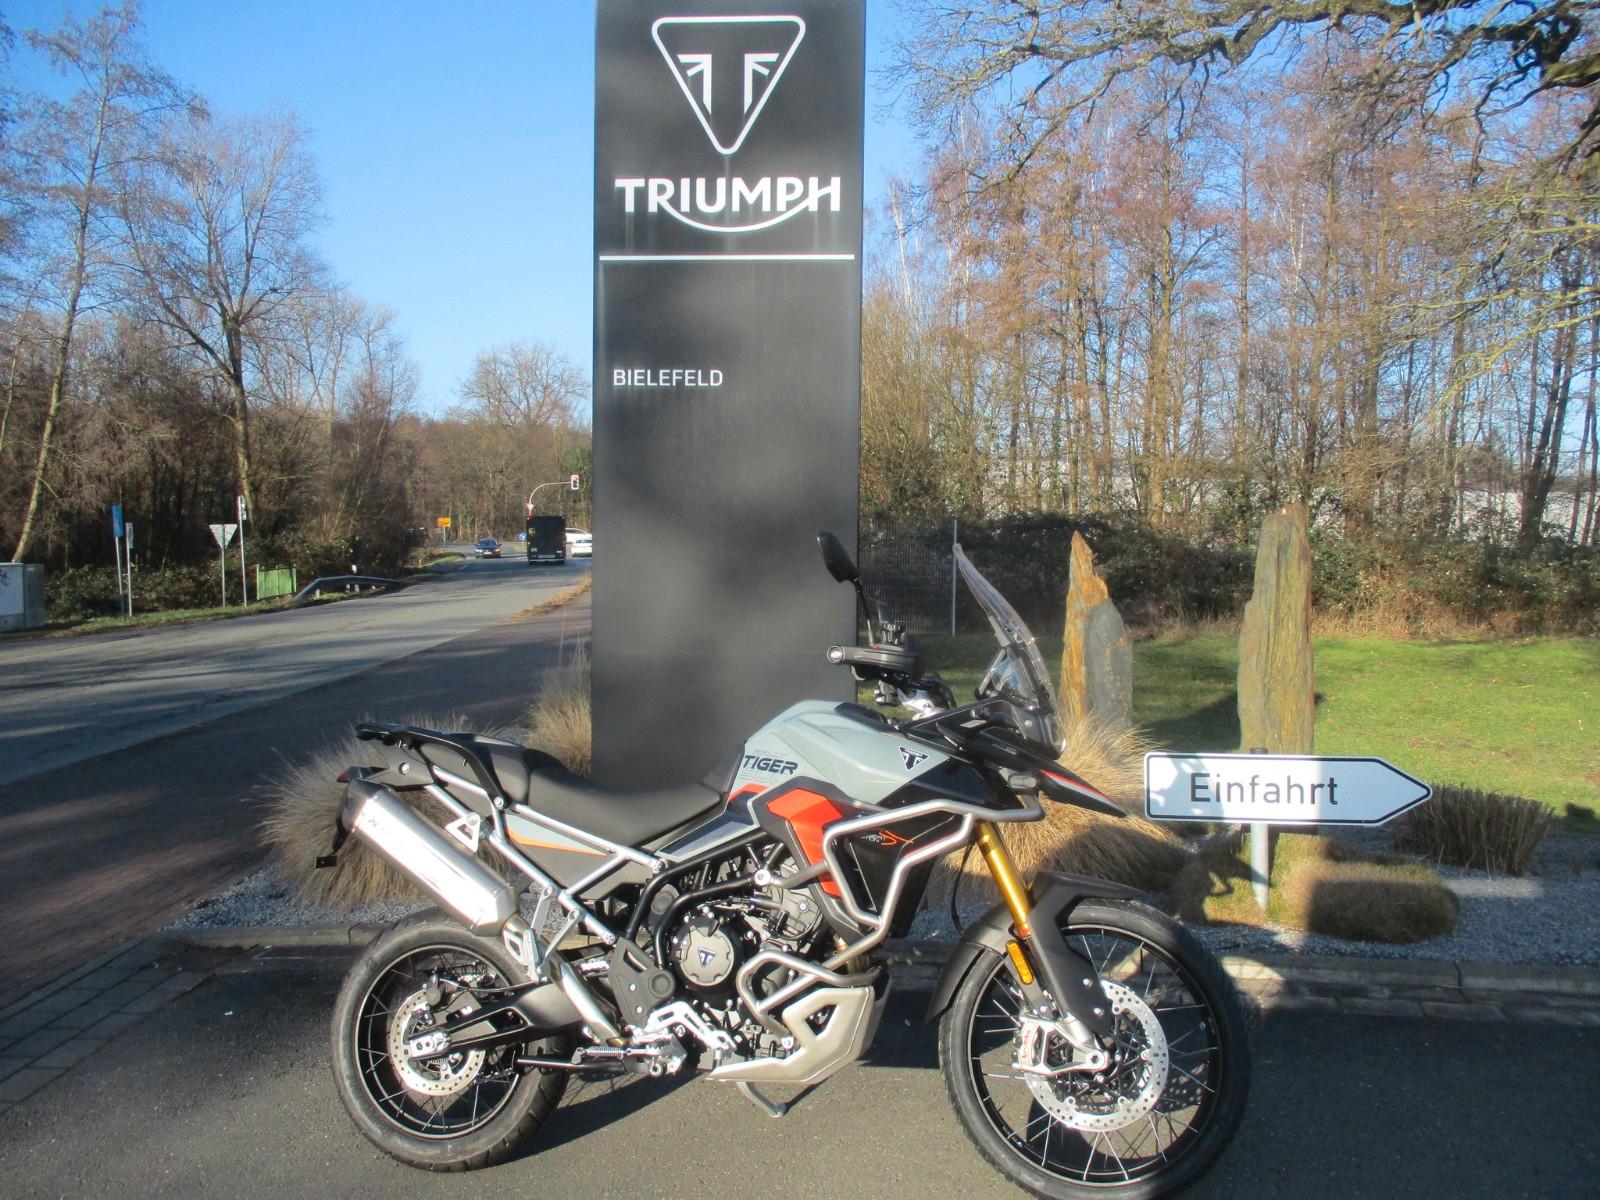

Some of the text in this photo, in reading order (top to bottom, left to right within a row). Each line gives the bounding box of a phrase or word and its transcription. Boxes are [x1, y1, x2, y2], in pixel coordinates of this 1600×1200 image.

[614, 176, 841, 233] TRIUMPH
[613, 369, 723, 387] BIELEFELD
[743, 755, 798, 775] TIGER
[1190, 772, 1338, 806] Einfahrt
